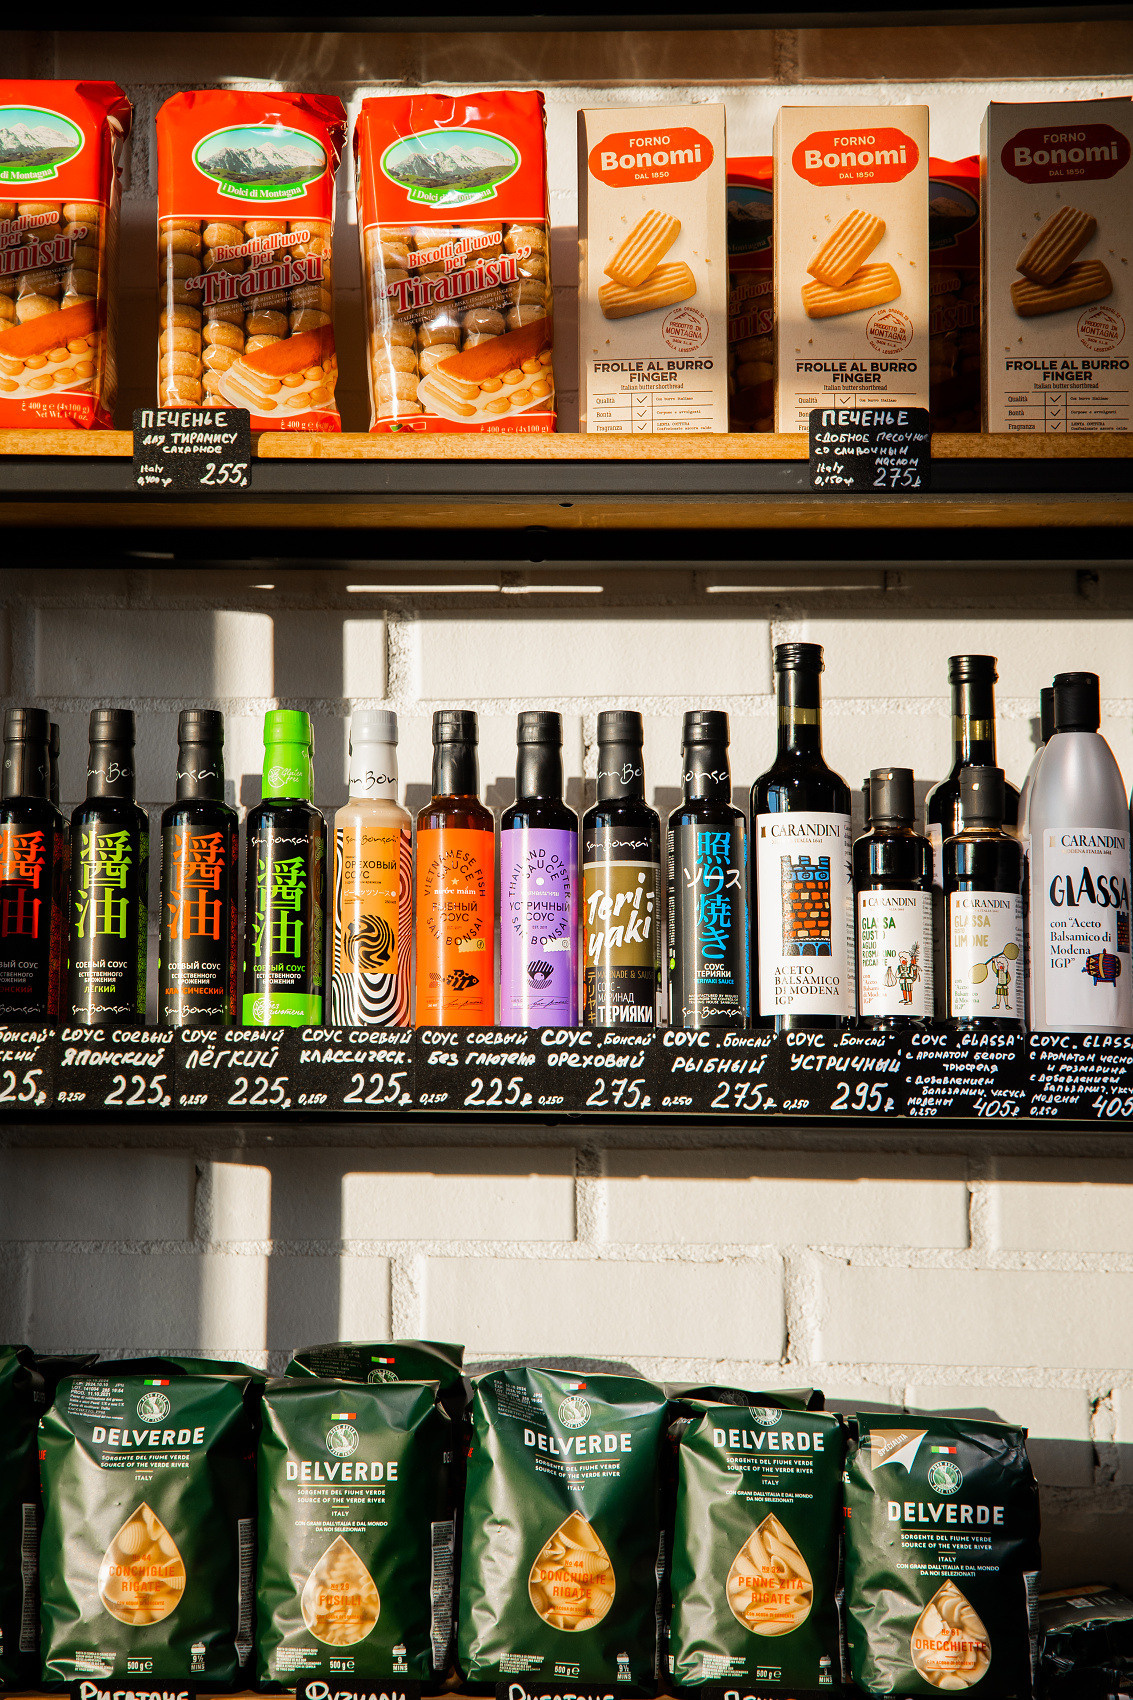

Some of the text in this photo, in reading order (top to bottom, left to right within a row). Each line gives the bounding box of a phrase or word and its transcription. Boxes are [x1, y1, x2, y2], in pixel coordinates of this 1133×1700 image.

[629, 136, 670, 148] FORNO
[834, 136, 876, 146] FORNO
[1043, 133, 1086, 143] FORNO
[600, 144, 701, 171] Bonomi
[805, 146, 906, 169] Bonomi
[1014, 143, 1118, 166] Bonomi
[10, 168, 53, 179] Montagna
[635, 172, 649, 180] DAL
[228, 186, 248, 196] Dolci
[250, 188, 257, 196] di
[259, 186, 301, 198] Montagna
[215, 242, 260, 263] Biscotti
[407, 243, 453, 269] Biscotti
[252, 251, 274, 268] per
[444, 254, 466, 272] per
[870, 328, 907, 343] MONTAGNA
[594, 360, 713, 373] FROLLE AL BURRO
[796, 362, 917, 372] FROLLE AL BURRO
[1005, 360, 1130, 371] FROLLE AL BURRO
[629, 372, 678, 382] FINGER
[832, 372, 881, 383] FINGER
[1043, 371, 1092, 381] FINGER
[799, 396, 818, 405] Qualità
[1008, 394, 1028, 402] Qualità
[821, 410, 908, 426] ПЕЧЕНЬЕ
[1008, 408, 1025, 416] Bontà
[141, 410, 228, 428] ПЕЧЕНЬЕ
[1008, 423, 1036, 431] Fragranza
[140, 465, 163, 474] Italy
[816, 462, 844, 473] Italy
[771, 824, 840, 837] CARANDINI
[1061, 835, 1125, 850] CARANDINI
[476, 869, 485, 897] FISH
[1050, 867, 1128, 910] GLASSA
[1050, 932, 1111, 942] Balsamico di
[1050, 945, 1091, 955] Modena
[704, 963, 724, 971] СОУС
[775, 966, 813, 975] ACETO
[696, 970, 731, 978] ТЕРИЯКИ
[775, 976, 840, 985] BALSAMICO
[789, 986, 839, 995] MODENA
[775, 997, 793, 1005] IGP
[62, 1029, 105, 1042] СОУС
[302, 1029, 342, 1042] СОУС
[422, 1031, 459, 1044] СОУС
[540, 1030, 592, 1046] СОУС
[663, 1031, 710, 1047] СОУС
[787, 1033, 825, 1047] СОУС
[912, 1034, 947, 1046] СОУС
[1030, 1035, 1069, 1047] СОУС
[671, 1055, 767, 1073] РЫБНЫЙ
[58, 1092, 86, 1102] 0,250
[538, 1096, 564, 1105] 0,250
[783, 1099, 809, 1109] 0,250
[92, 1426, 204, 1446] DELVERDE
[524, 1429, 632, 1455] DELVERDE
[713, 1428, 824, 1451] DELVERDE
[286, 1461, 398, 1481] DELVERDE
[888, 1501, 1004, 1525] DELVERDE
[109, 1566, 175, 1578] CONCHIGLIE
[121, 1582, 160, 1592] RIGATE
[738, 1577, 804, 1590] PENNE ZITA
[320, 1595, 361, 1605] FUSILLI
[752, 1592, 790, 1605] RIGATE
[915, 1639, 986, 1651] ORECCHIETTE
[127, 1661, 138, 1670] 500
[140, 1662, 144, 1671] g
[330, 1661, 346, 1670] 500 g
